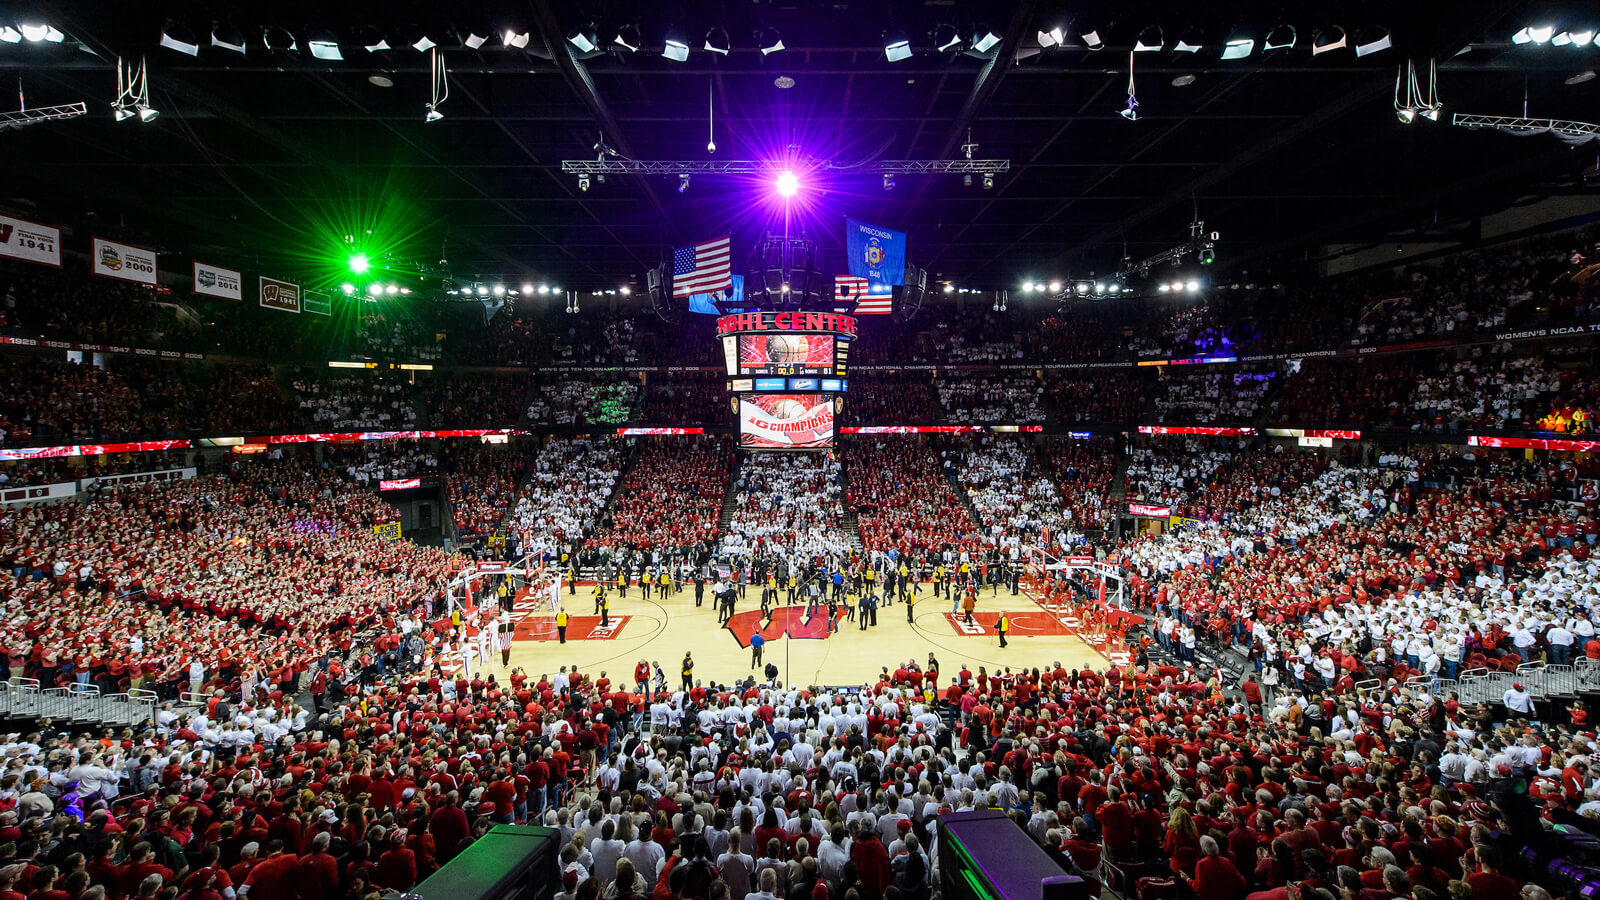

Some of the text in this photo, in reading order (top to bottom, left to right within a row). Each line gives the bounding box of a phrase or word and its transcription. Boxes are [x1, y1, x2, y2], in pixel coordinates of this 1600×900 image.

[860, 225, 892, 240] WISCONSIN
[19, 239, 54, 252] 1941
[126, 261, 153, 273] 2000
[218, 281, 238, 290] 2014
[718, 312, 855, 334] KOHL CENTER
[1495, 329, 1546, 340] WOMEN'S
[1550, 326, 1584, 335] NCAA
[748, 411, 834, 432] 16 CHAMPIONS
